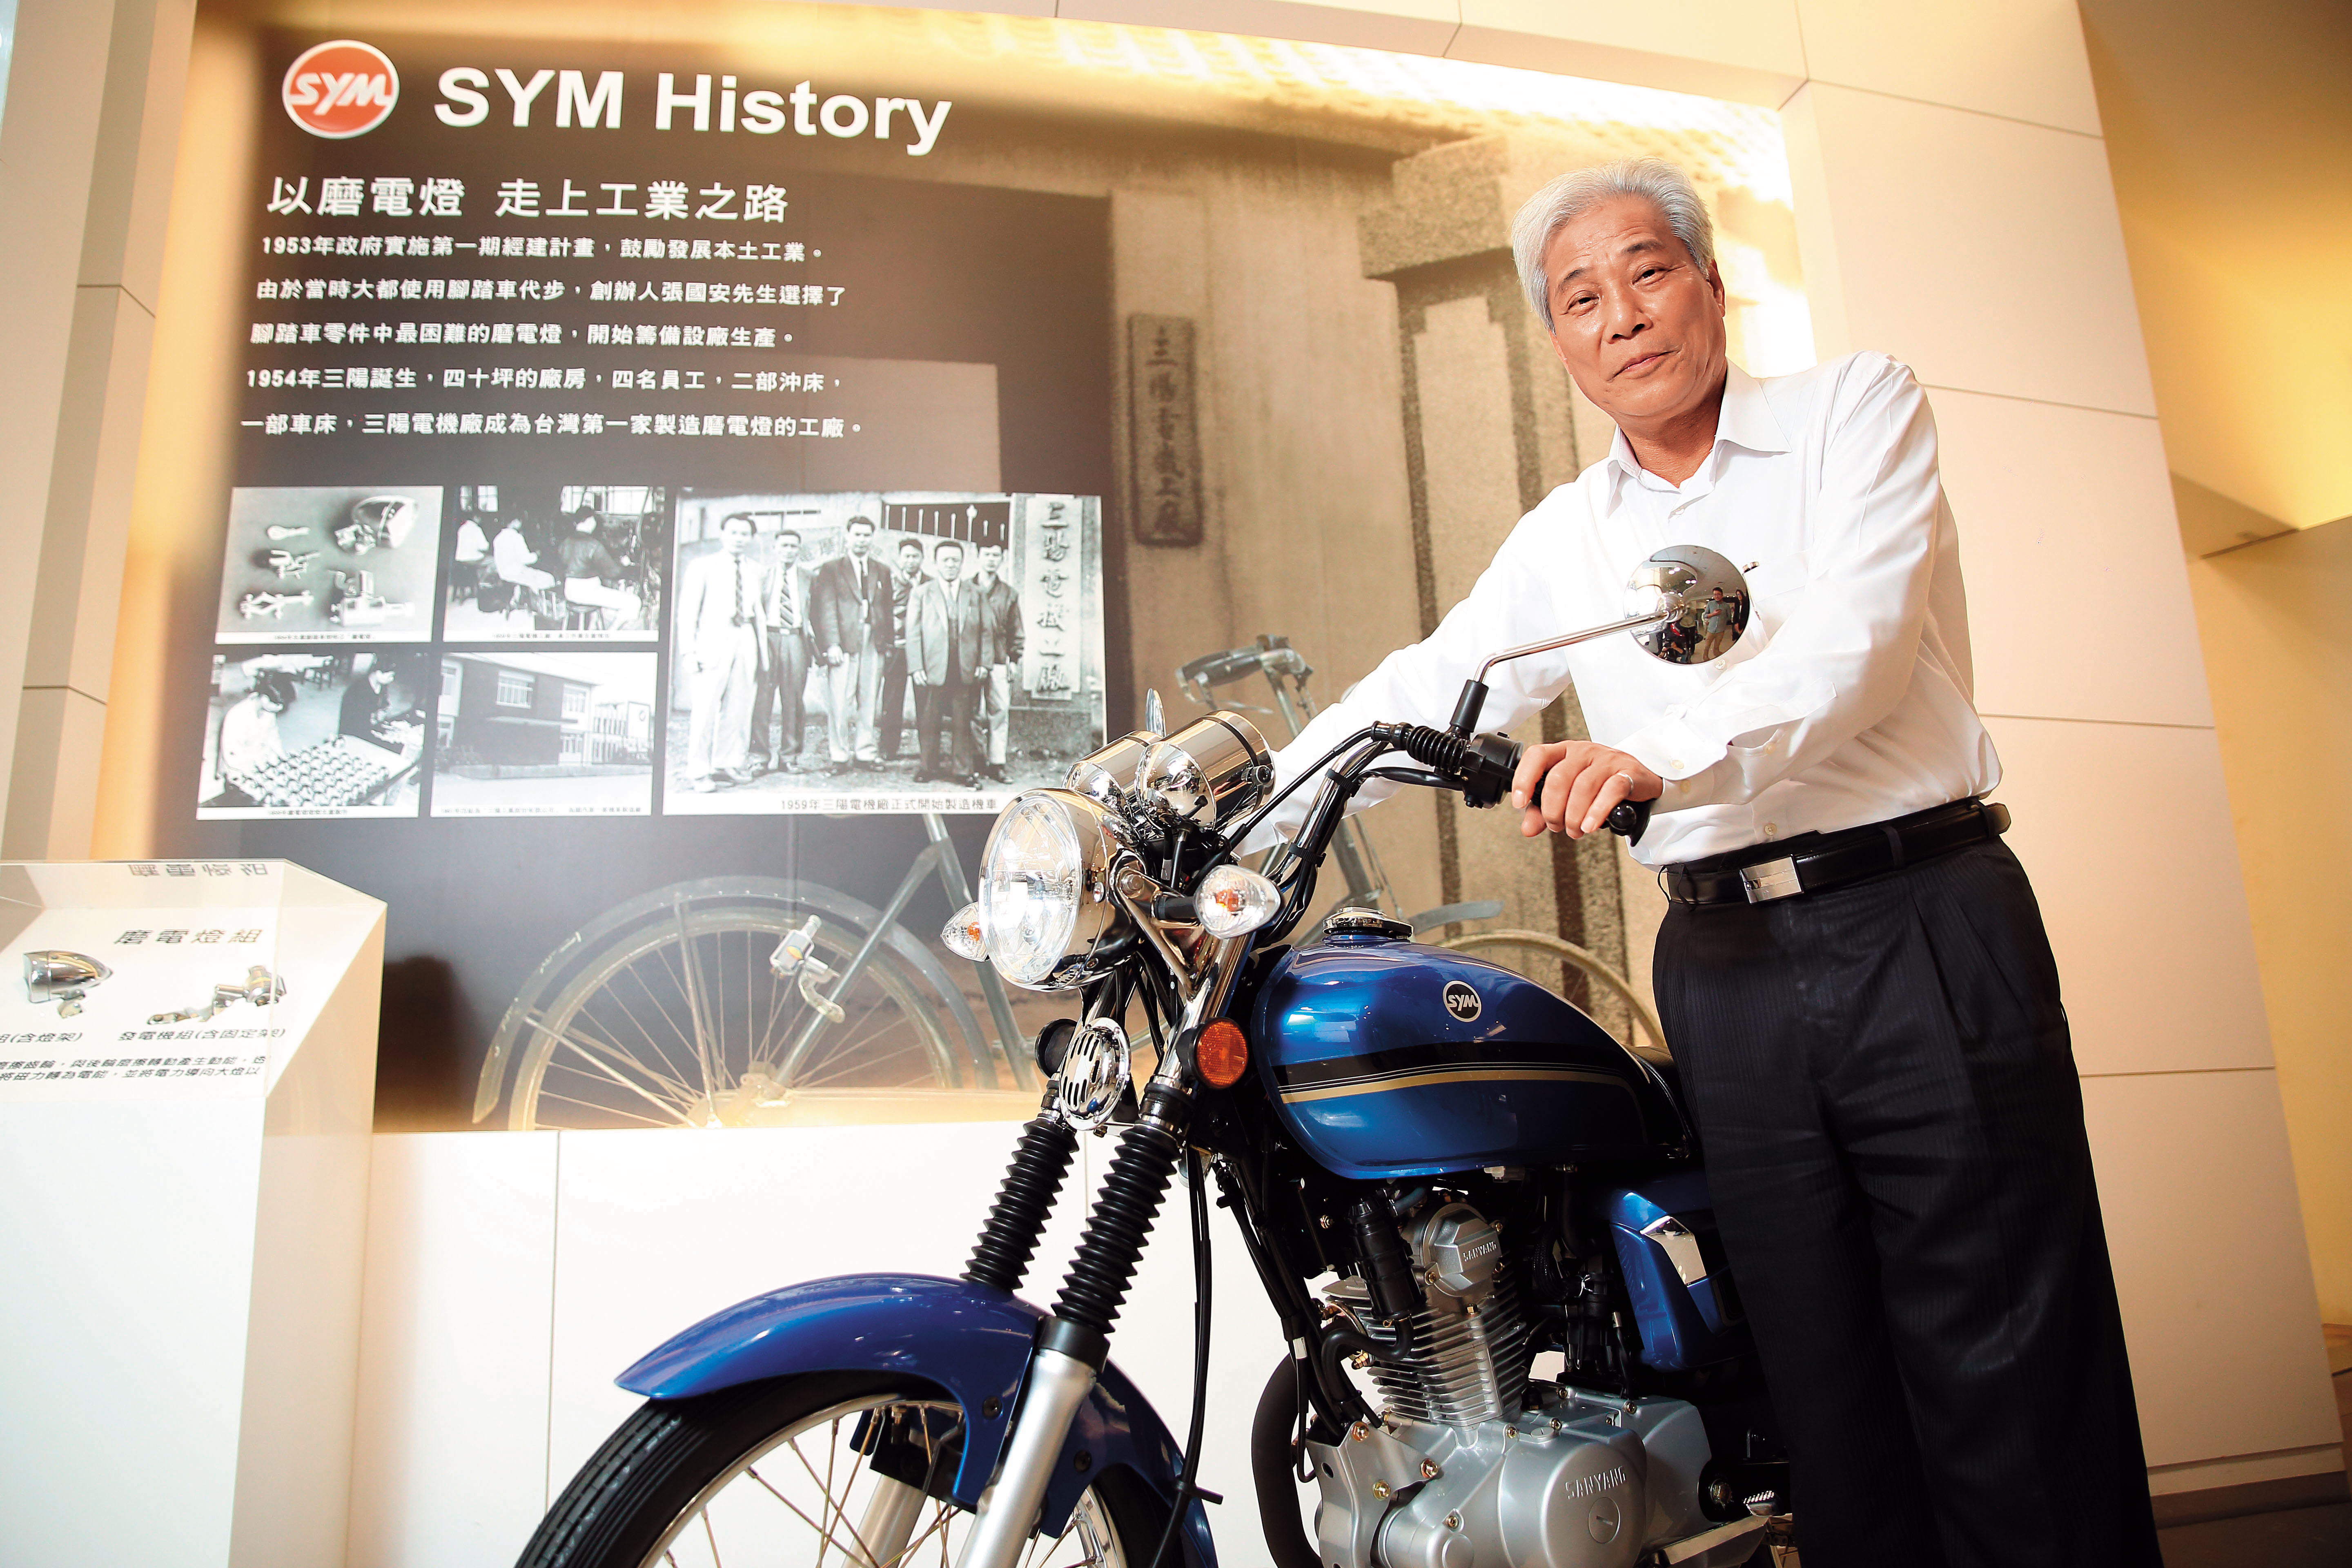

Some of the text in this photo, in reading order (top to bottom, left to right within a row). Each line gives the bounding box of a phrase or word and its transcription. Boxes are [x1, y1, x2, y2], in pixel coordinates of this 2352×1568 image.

[287, 72, 393, 116] SYM
[434, 67, 953, 156] SYM History
[266, 176, 789, 223] 以磨電燈 走上工業之路
[781, 798, 997, 811] 1959年三陽電機廠正式開始製造機車
[114, 929, 263, 945] 磨電燈組
[1448, 995, 1479, 1011] SYM
[1463, 1241, 1497, 1263] SANYANG
[1565, 1466, 1626, 1499] SANYANG
